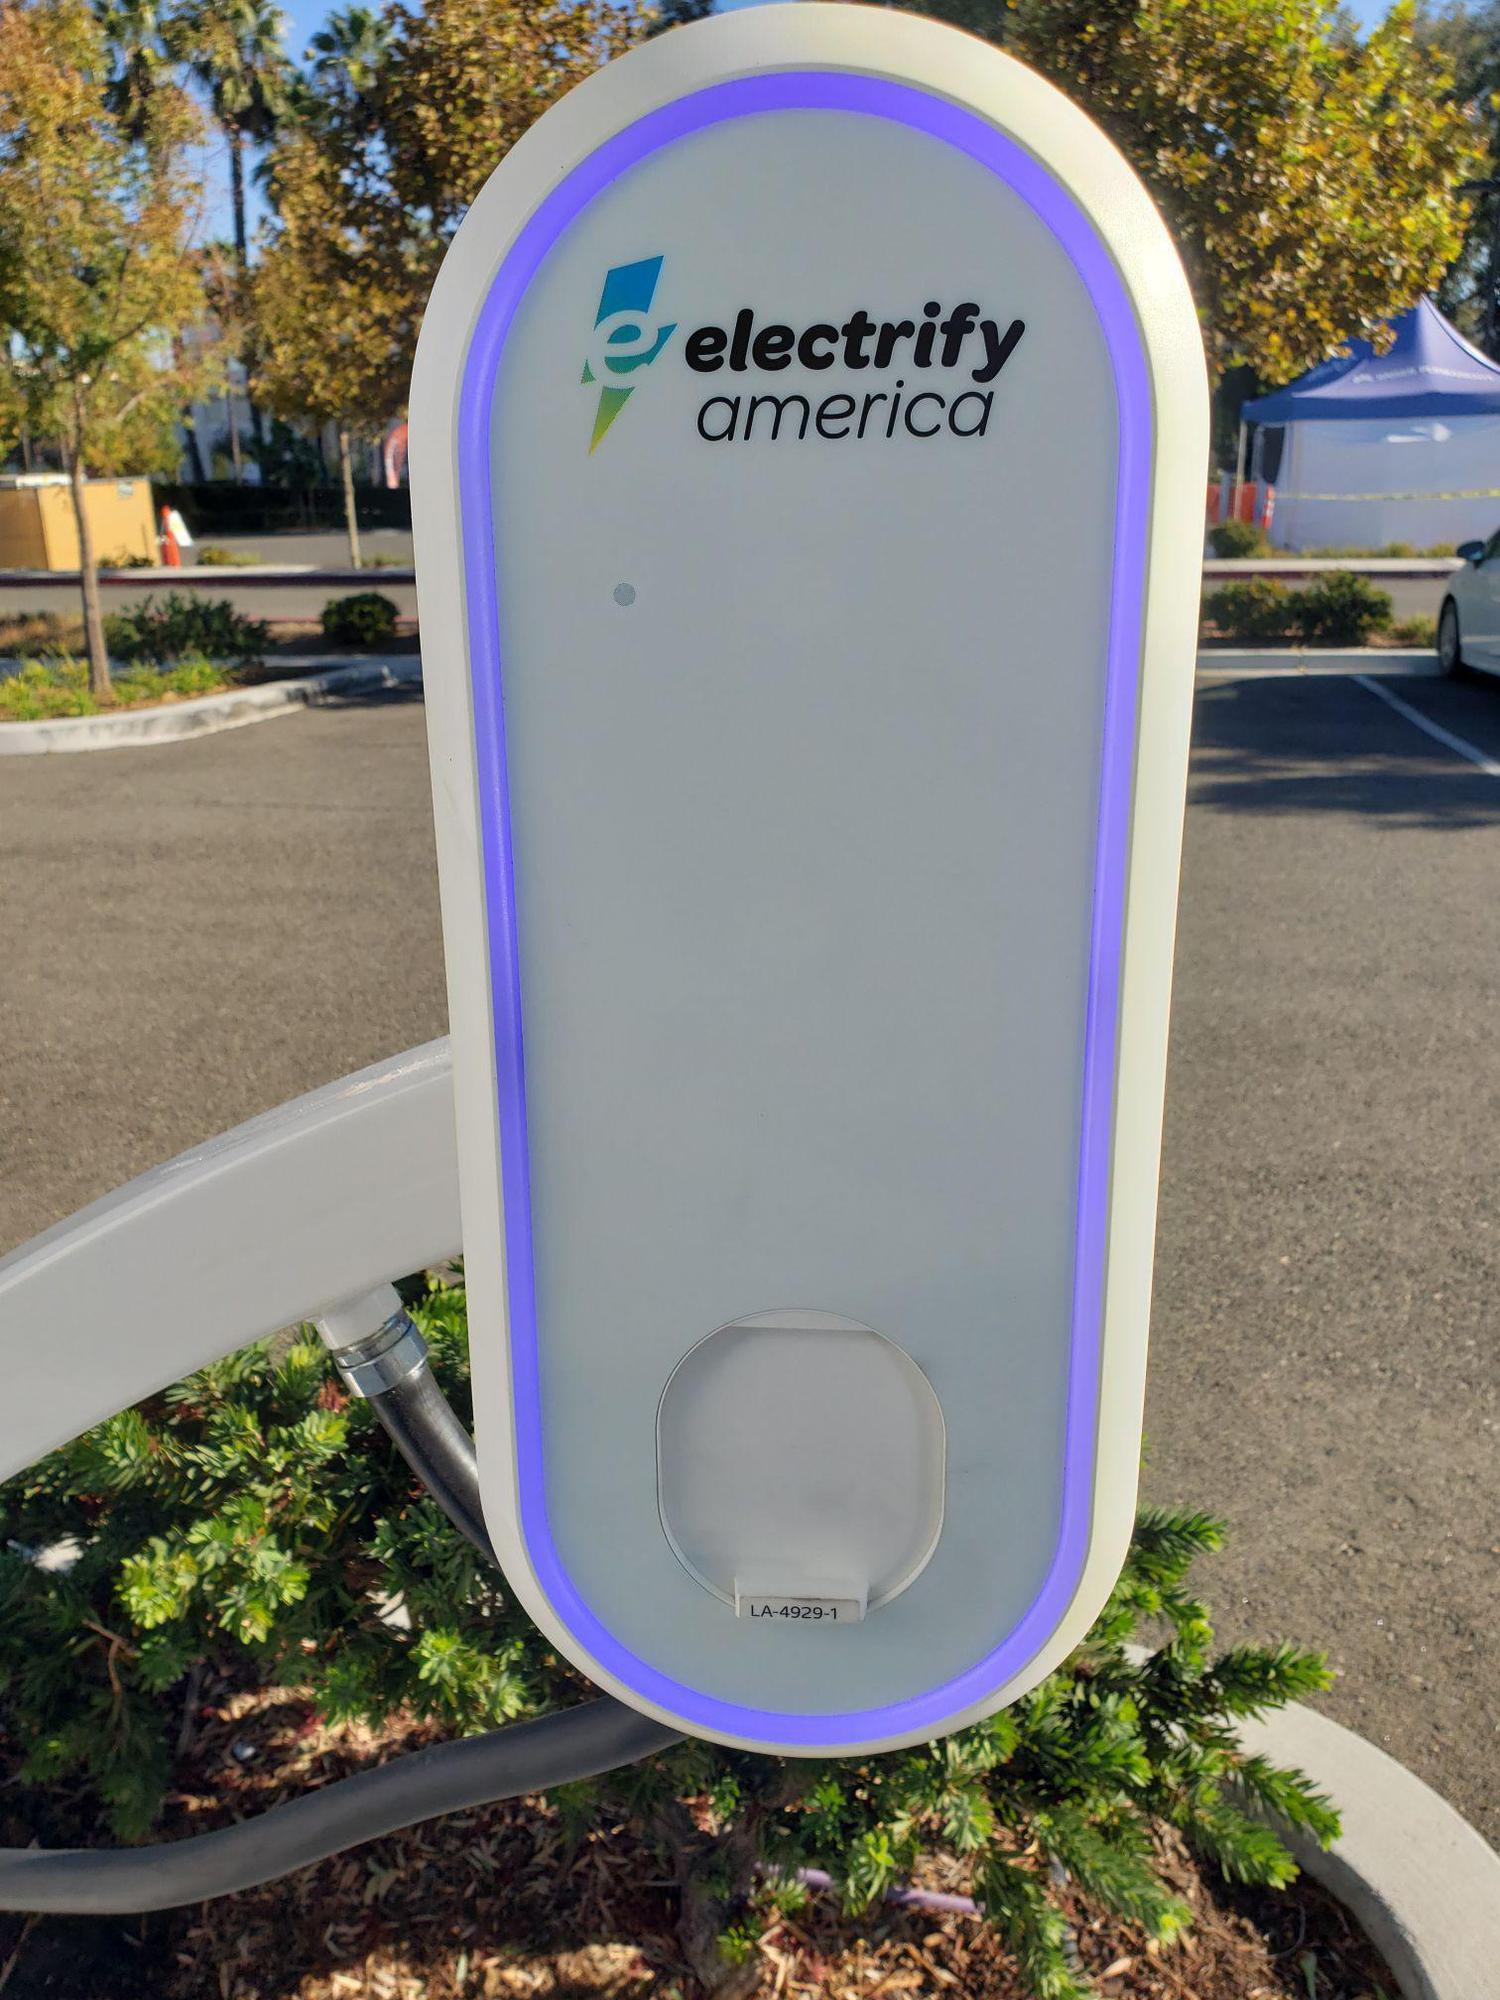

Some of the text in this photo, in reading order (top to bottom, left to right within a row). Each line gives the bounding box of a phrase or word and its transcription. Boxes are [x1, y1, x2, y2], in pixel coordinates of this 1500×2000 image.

[684, 301, 1026, 384] electrify
[697, 379, 995, 442] america
[750, 1604, 838, 1621] LA-4929-1
